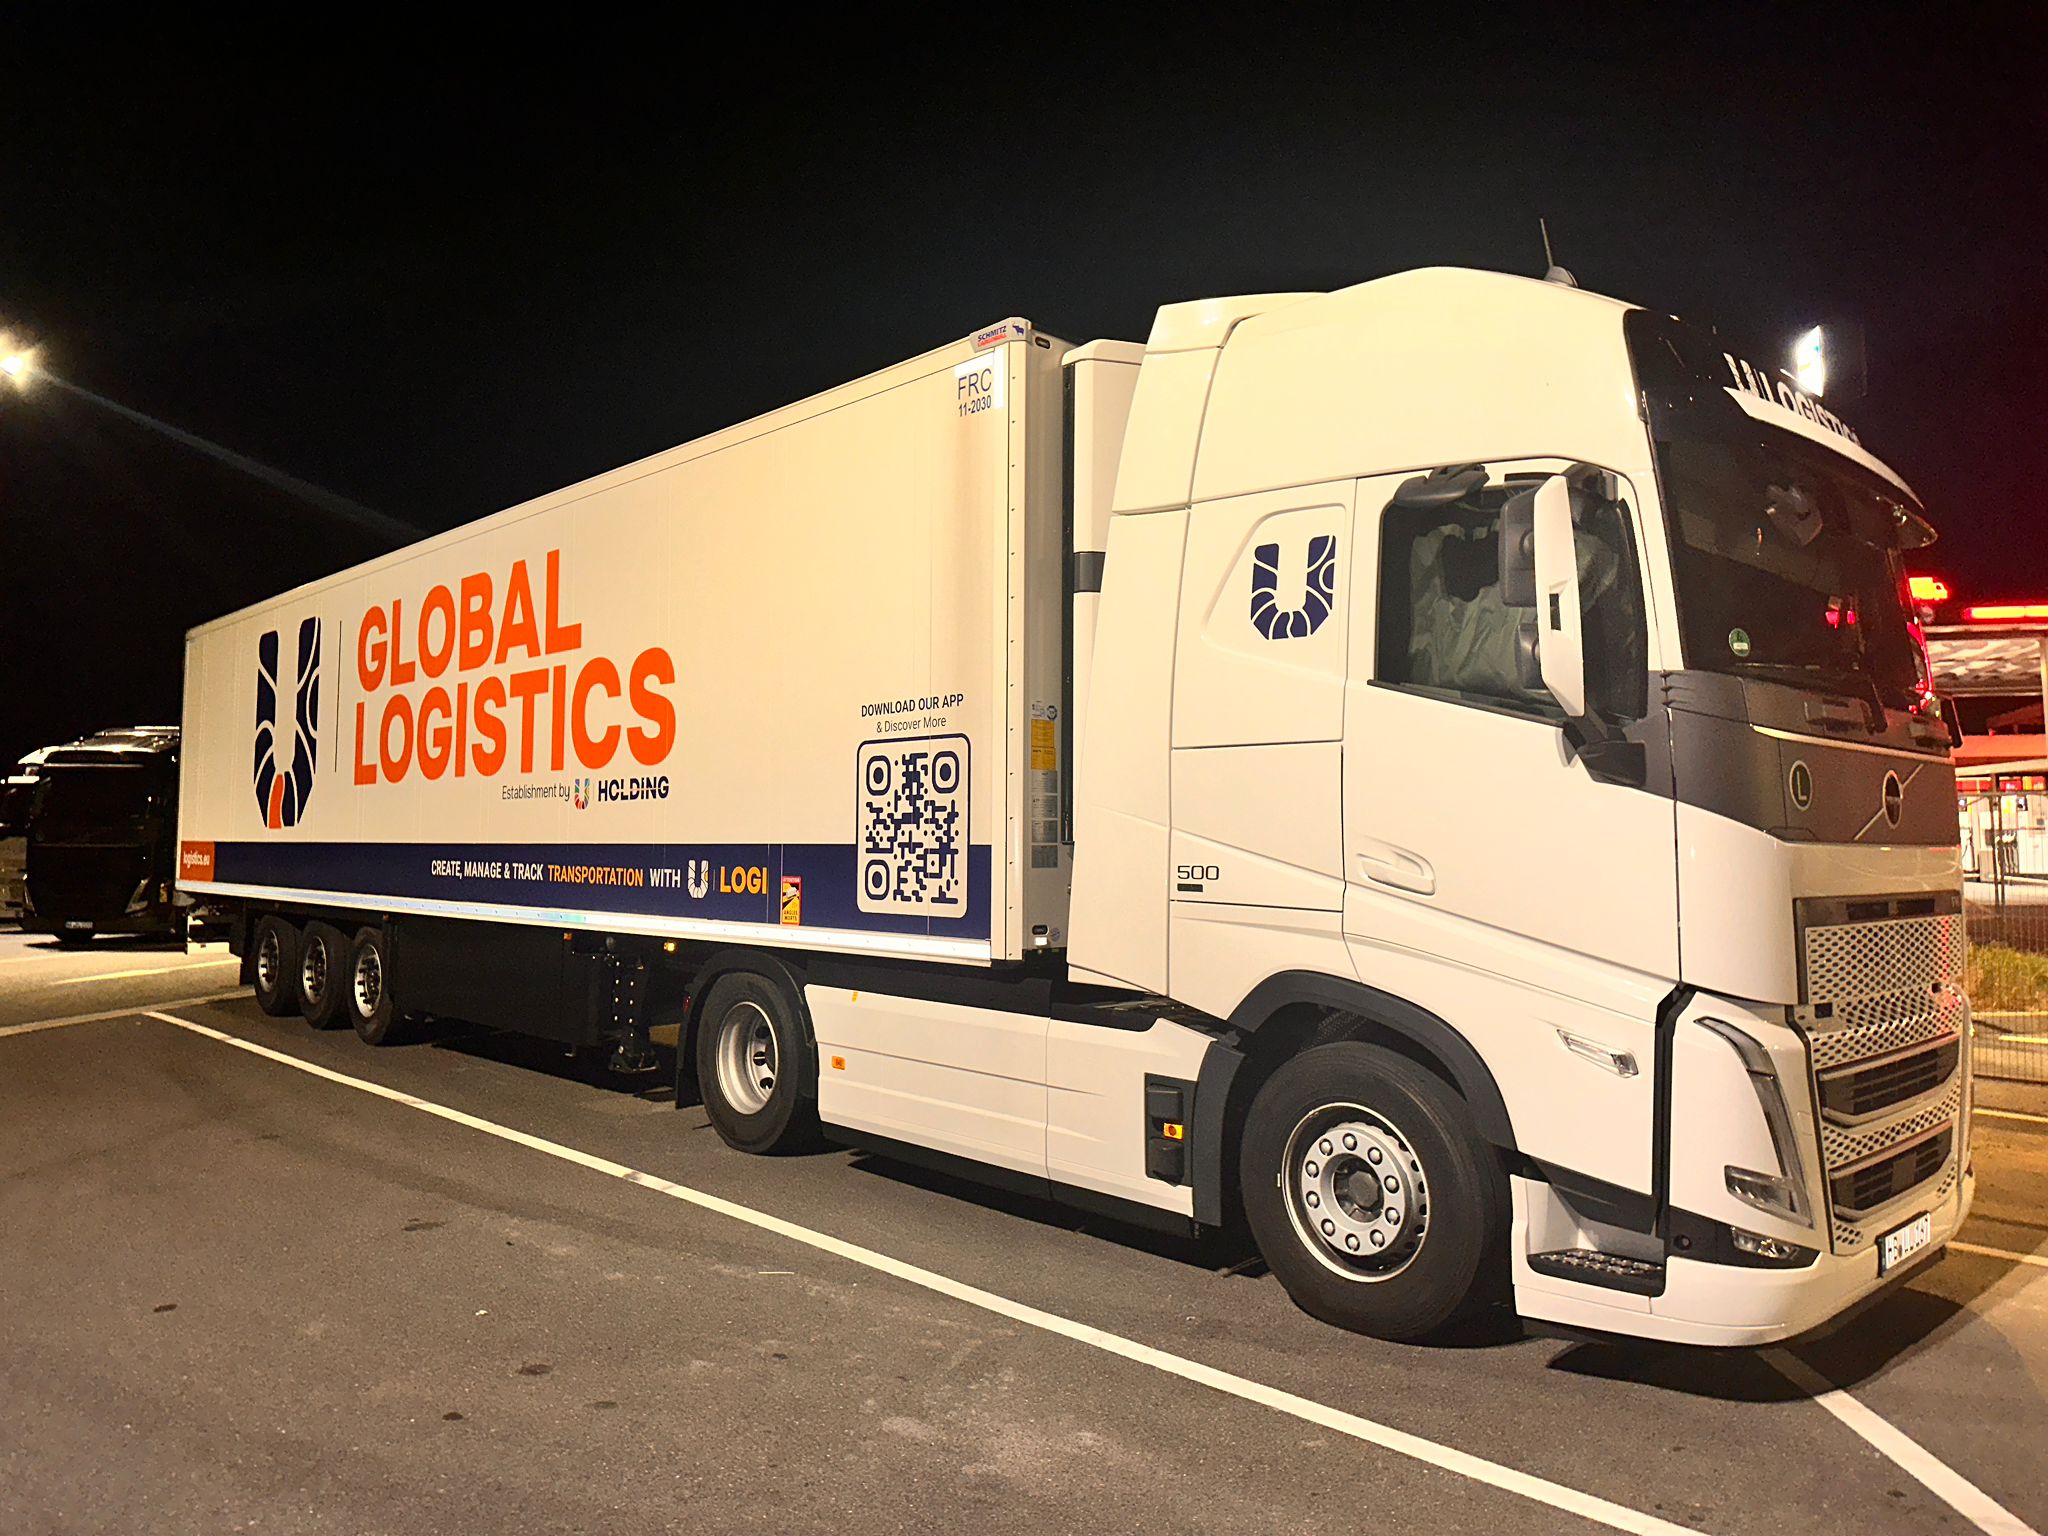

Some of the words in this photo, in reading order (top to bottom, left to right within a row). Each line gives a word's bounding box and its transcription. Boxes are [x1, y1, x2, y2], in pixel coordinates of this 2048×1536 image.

[977, 325, 1007, 342] SCHMITZ
[958, 368, 992, 400] FRC
[958, 394, 992, 418] 11-2030
[357, 549, 582, 692] GLOBAL
[354, 646, 677, 786] LOGISTICS
[861, 699, 916, 718] DOWNLOAD
[918, 696, 940, 711] OUR
[942, 693, 964, 709] APP
[876, 721, 883, 733] &
[884, 718, 921, 733] Discover
[923, 716, 947, 729] More
[502, 783, 557, 800] Establishment
[558, 783, 571, 802] by
[598, 776, 669, 802] HOLDING
[431, 860, 463, 880] CREATE,
[464, 861, 502, 879] MANAGE
[503, 864, 511, 880] &
[512, 863, 544, 881] TRACK
[548, 864, 644, 888] TRANSPORTATION
[649, 868, 681, 888] WITH
[720, 866, 768, 895] LOGI
[1177, 865, 1219, 880] 500
